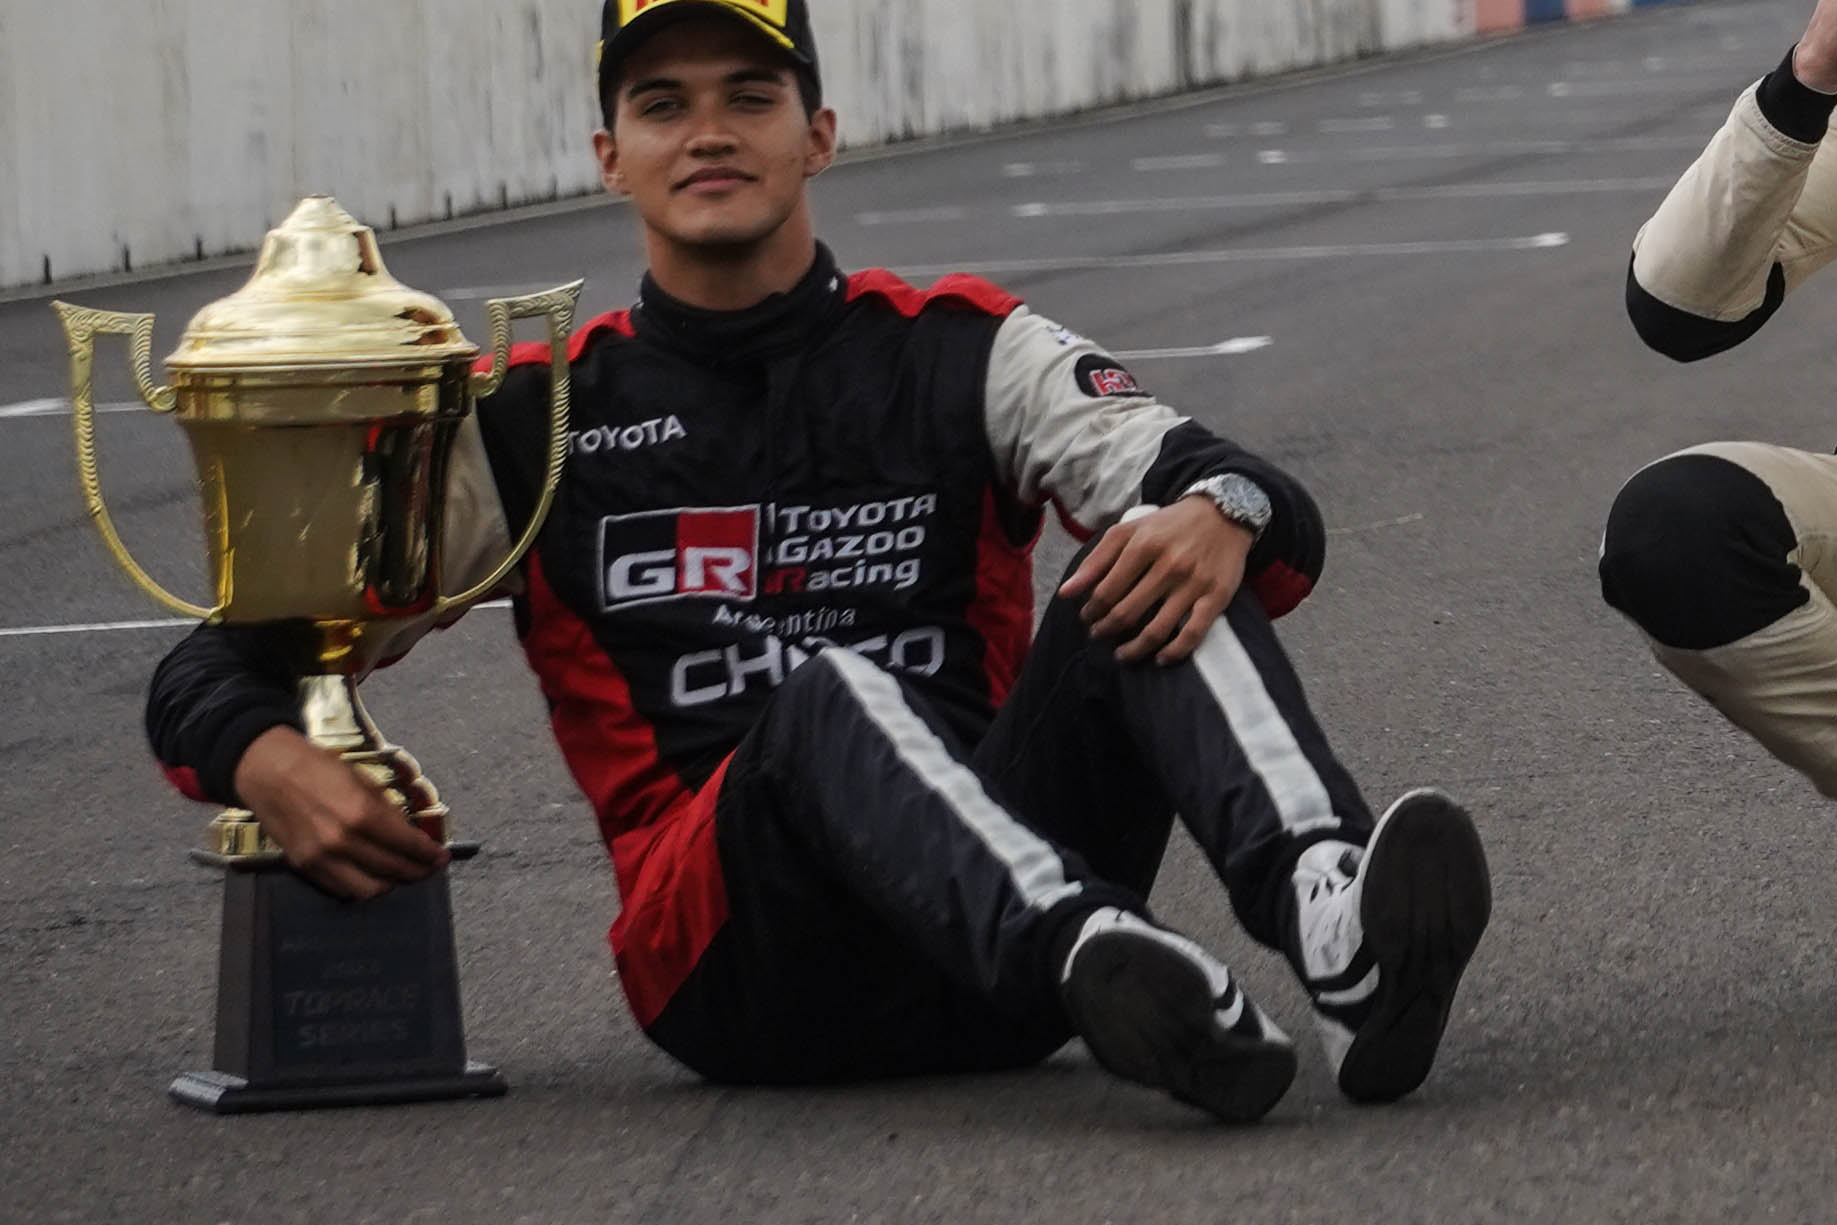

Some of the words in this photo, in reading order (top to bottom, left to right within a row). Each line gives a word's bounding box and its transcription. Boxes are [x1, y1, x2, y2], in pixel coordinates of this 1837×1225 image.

[568, 414, 688, 456] TOYOTA
[778, 494, 937, 533] TOYOTA
[777, 526, 926, 564] GAZOO
[607, 547, 752, 600] GR
[764, 558, 921, 593] Racing
